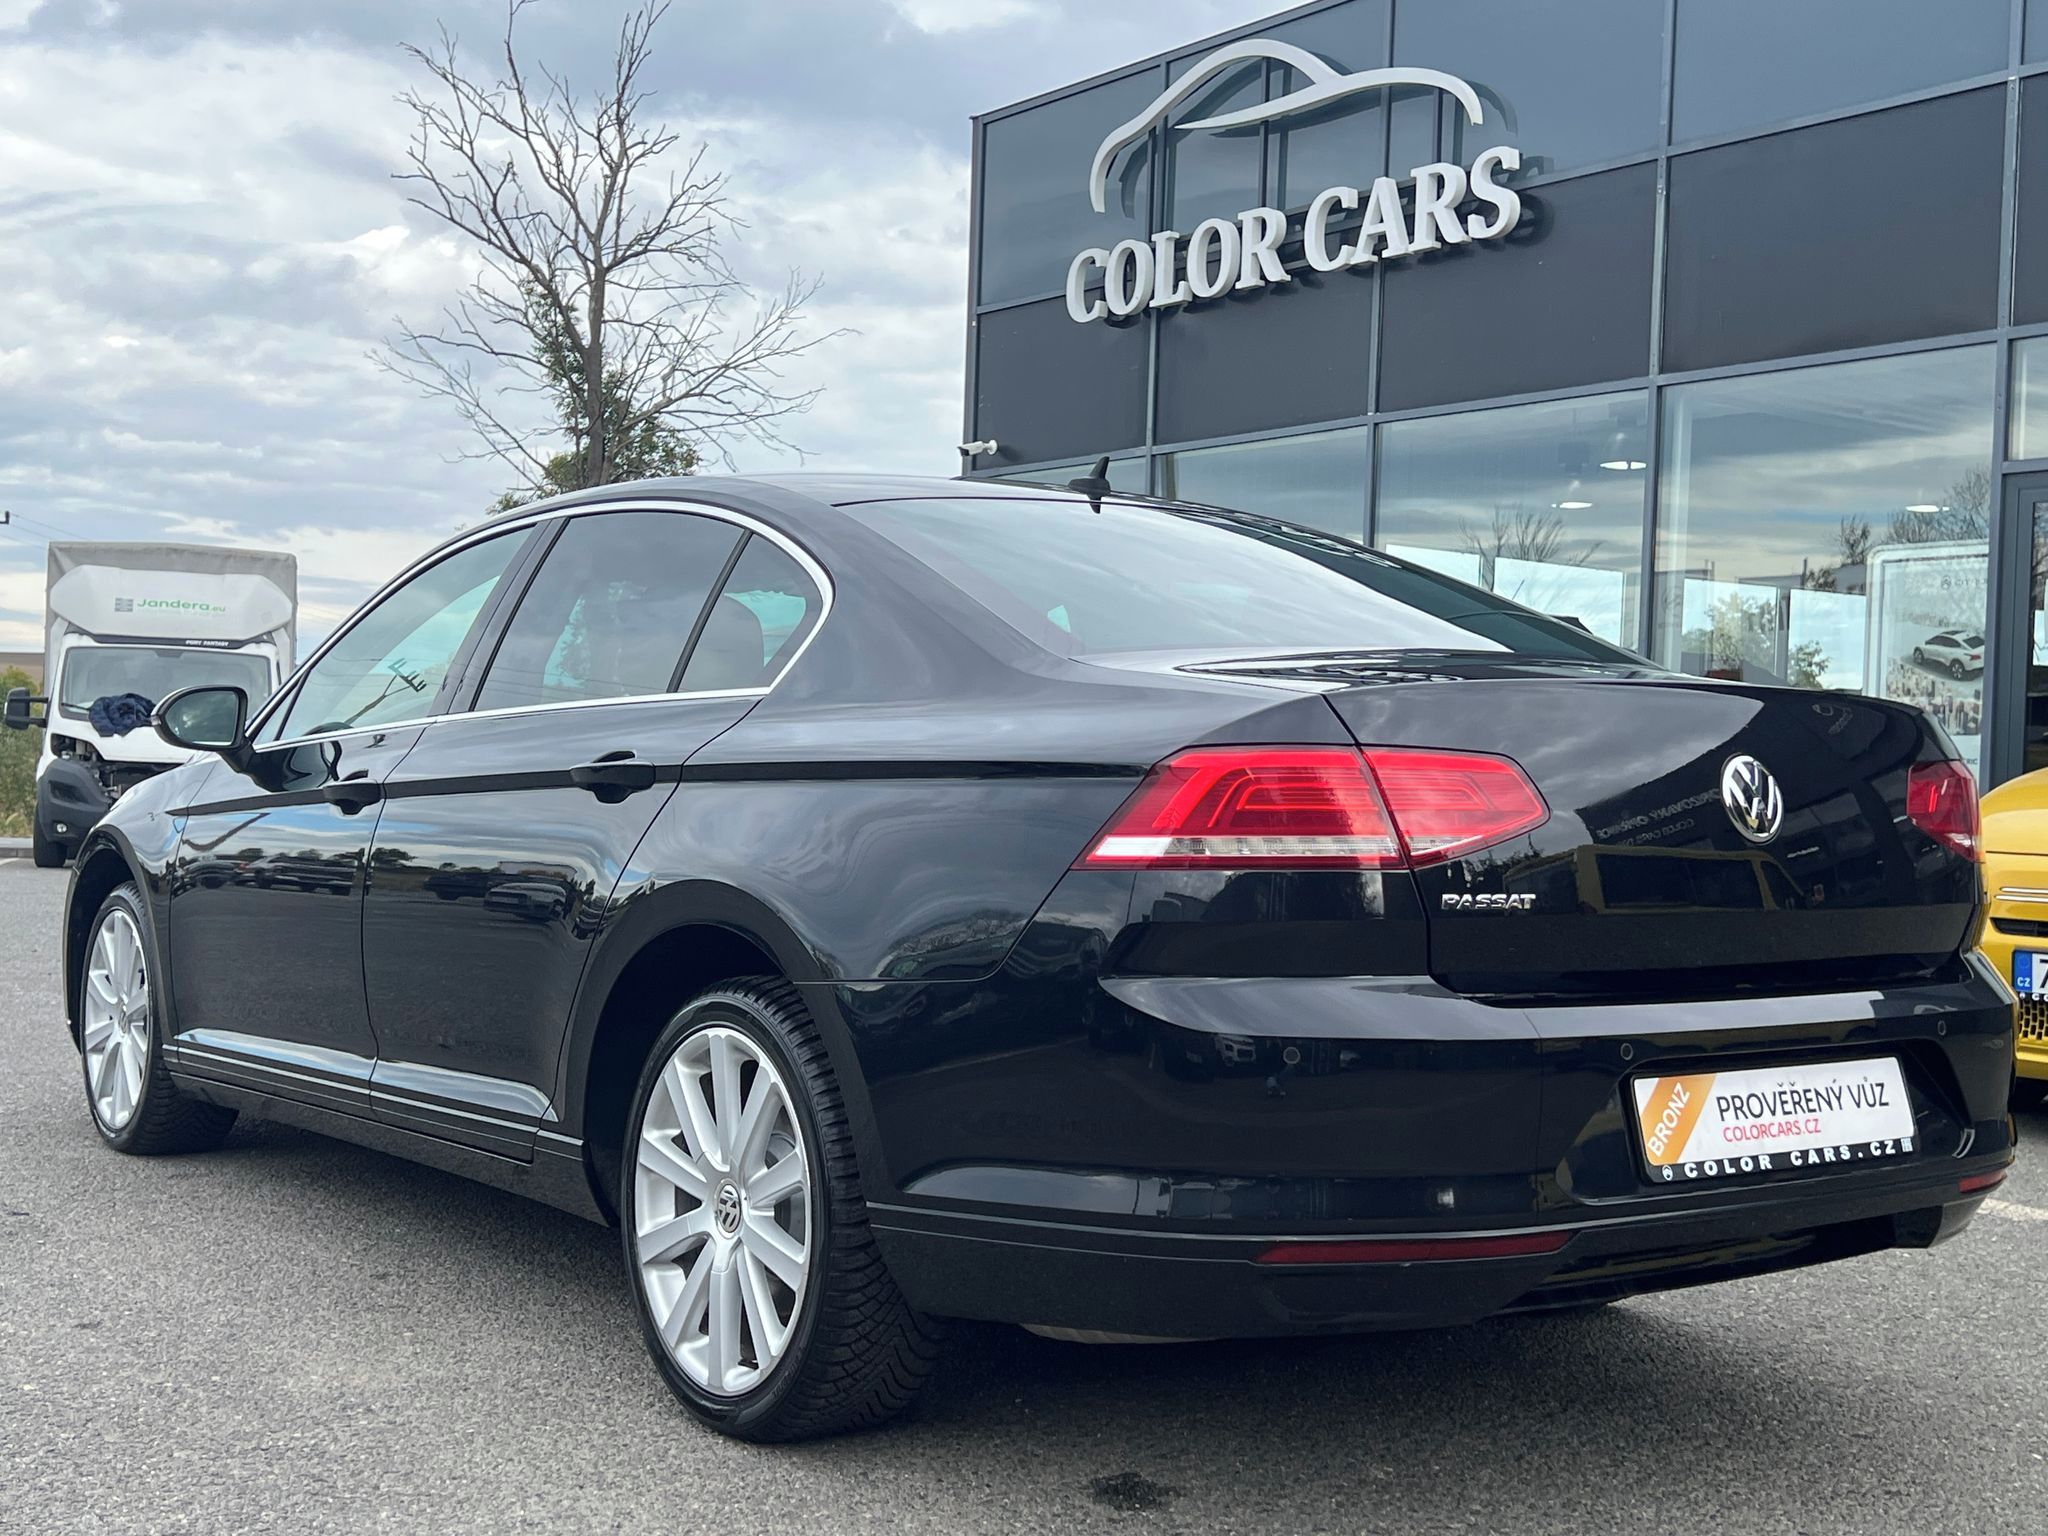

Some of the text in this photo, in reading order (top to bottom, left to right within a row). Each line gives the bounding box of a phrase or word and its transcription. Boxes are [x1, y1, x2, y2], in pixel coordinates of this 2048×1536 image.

[1065, 146, 1521, 324] COLOR CARS
[137, 599, 226, 612] Jandera.eu
[1441, 893, 1537, 910] PASSAT
[2017, 976, 2031, 988] CZ
[1716, 1076, 1889, 1122] PROVĚŘENÝ VŮZ
[1647, 1082, 1690, 1158] BRONZ
[1723, 1118, 1821, 1142] COLORCARS.CZ
[1683, 1153, 1773, 1179] COLOR
